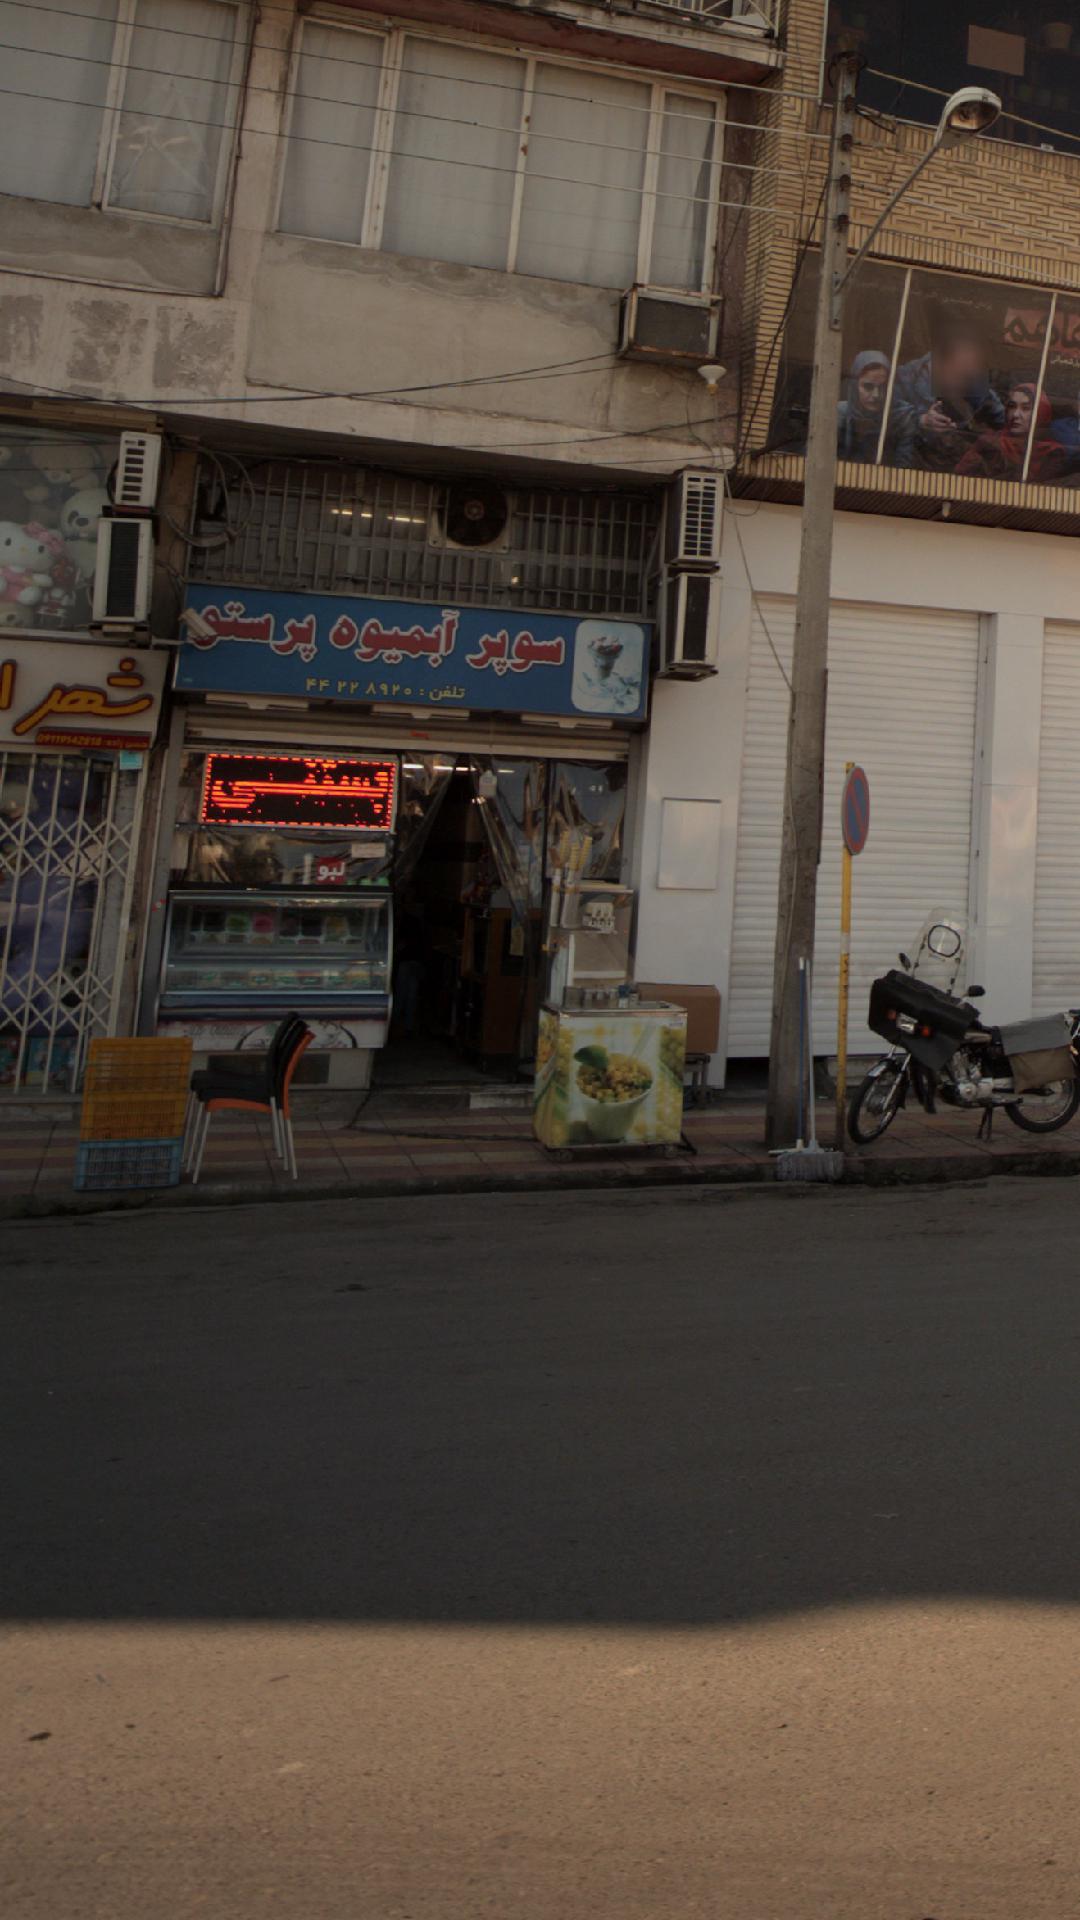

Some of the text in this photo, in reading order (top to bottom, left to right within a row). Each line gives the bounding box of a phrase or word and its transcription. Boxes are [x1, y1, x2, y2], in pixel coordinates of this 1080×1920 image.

[189, 602, 566, 677] سوپر آبمیوه پرستو
[429, 685, 466, 701] تلفن
